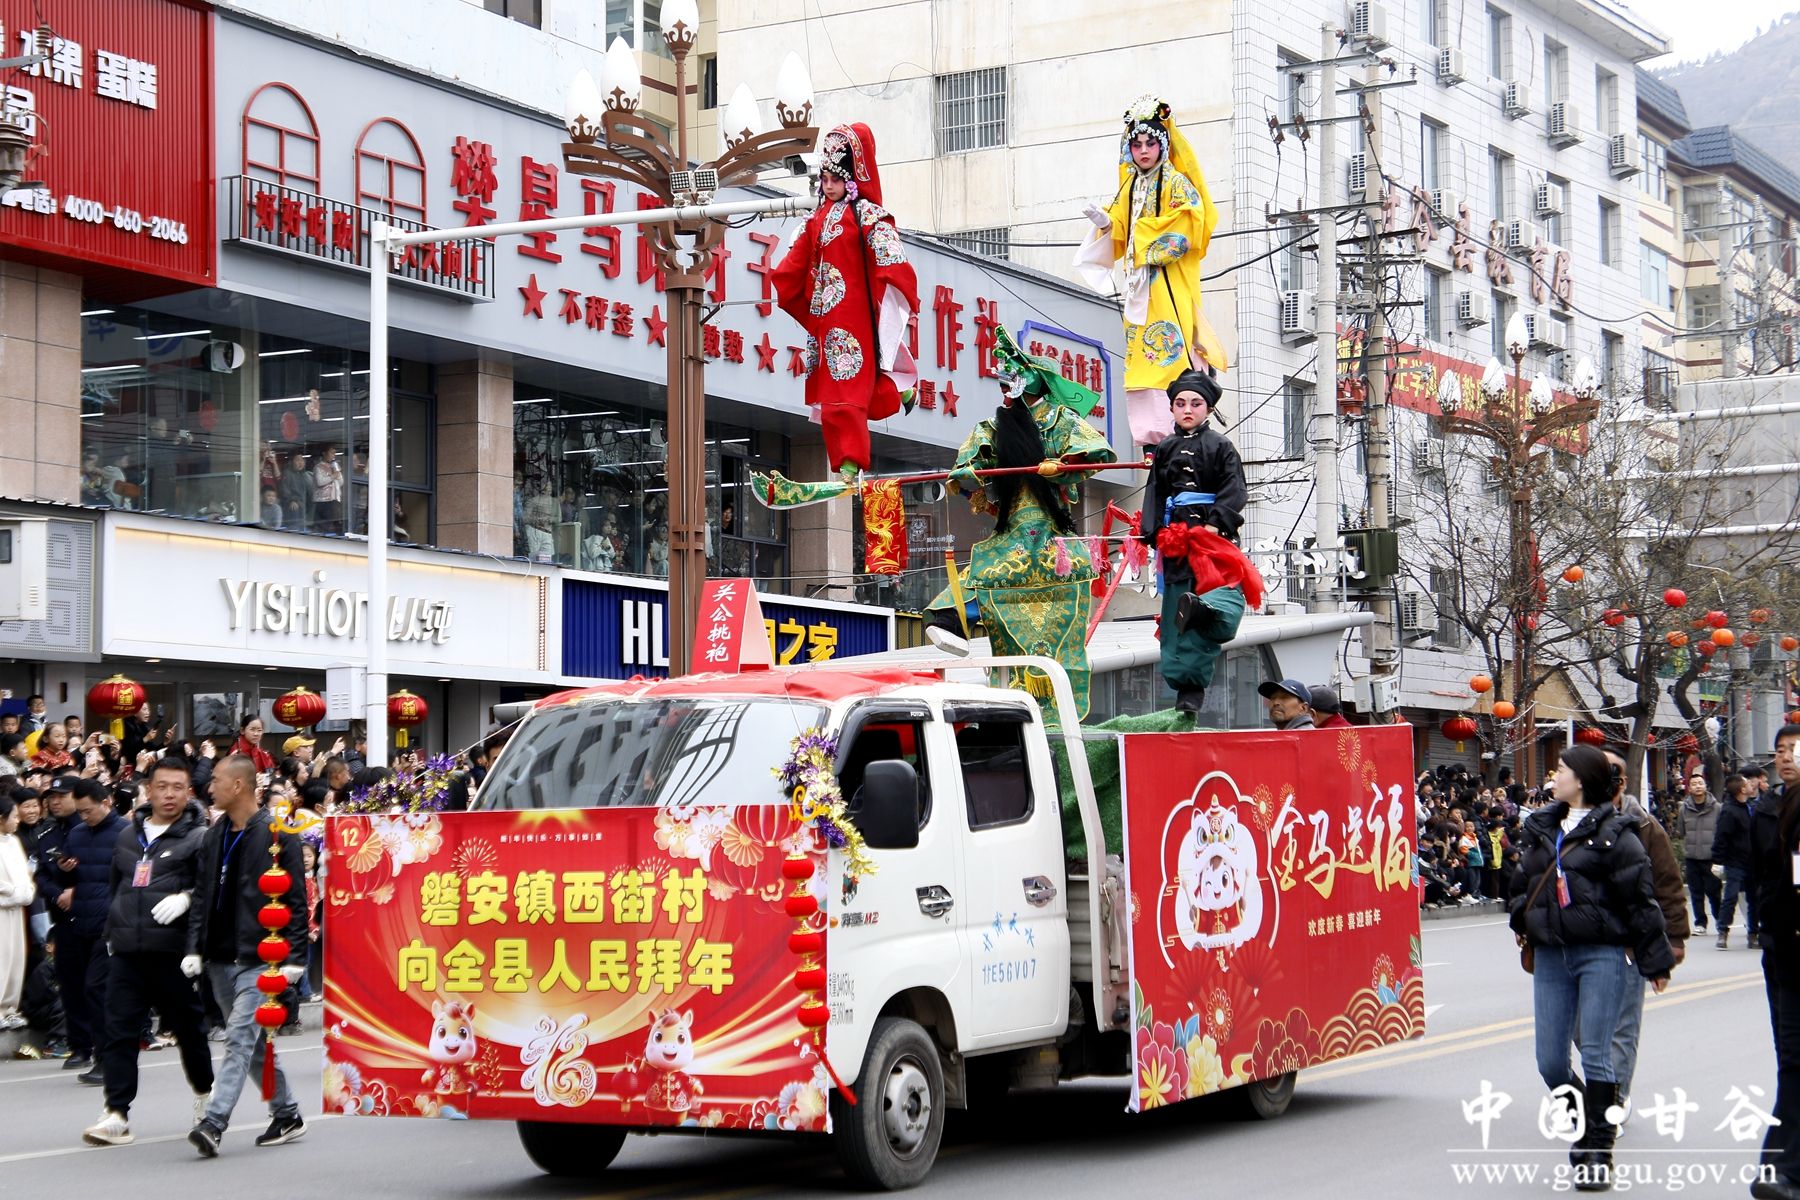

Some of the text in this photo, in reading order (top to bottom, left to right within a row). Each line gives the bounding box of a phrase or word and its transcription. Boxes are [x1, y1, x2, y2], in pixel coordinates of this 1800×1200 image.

[20, 29, 83, 89] 水果
[97, 48, 157, 110] 蛋糕
[64, 194, 189, 246] 4000-660-2066
[254, 189, 354, 252] 好好吃饭
[387, 595, 456, 646] 以纯
[704, 582, 737, 664] 关公挑袍
[764, 617, 839, 667] 之家
[341, 827, 361, 848] 12
[420, 868, 708, 926] 磐安镇西街村
[1307, 908, 1382, 937] 欢度新春 喜迎新年
[397, 937, 734, 995] 向全县人民拜年
